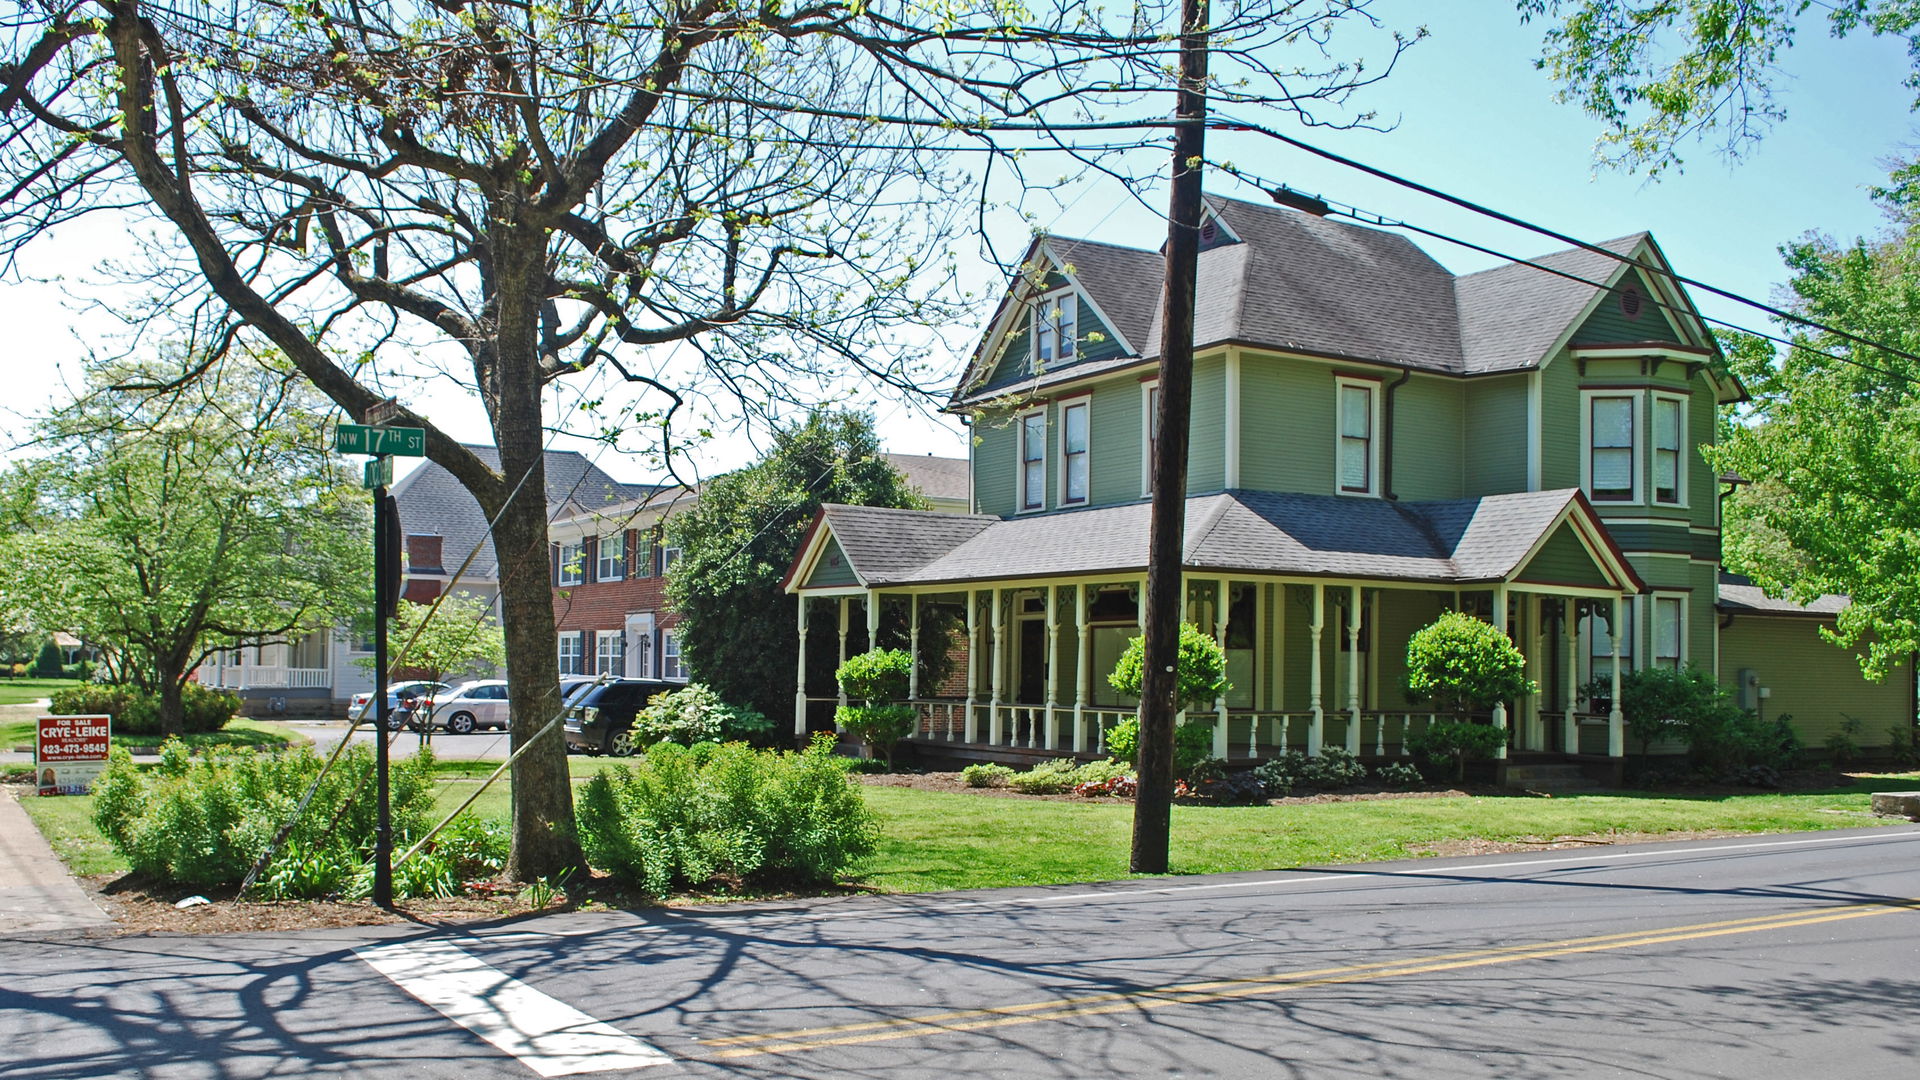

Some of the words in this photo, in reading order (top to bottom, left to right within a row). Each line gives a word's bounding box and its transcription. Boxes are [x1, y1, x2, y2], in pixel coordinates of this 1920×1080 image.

[340, 432, 358, 445] NW
[408, 436, 422, 449] ST
[41, 726, 107, 738] CRYE-LEIKE
[42, 743, 107, 754] 423-473-9545
